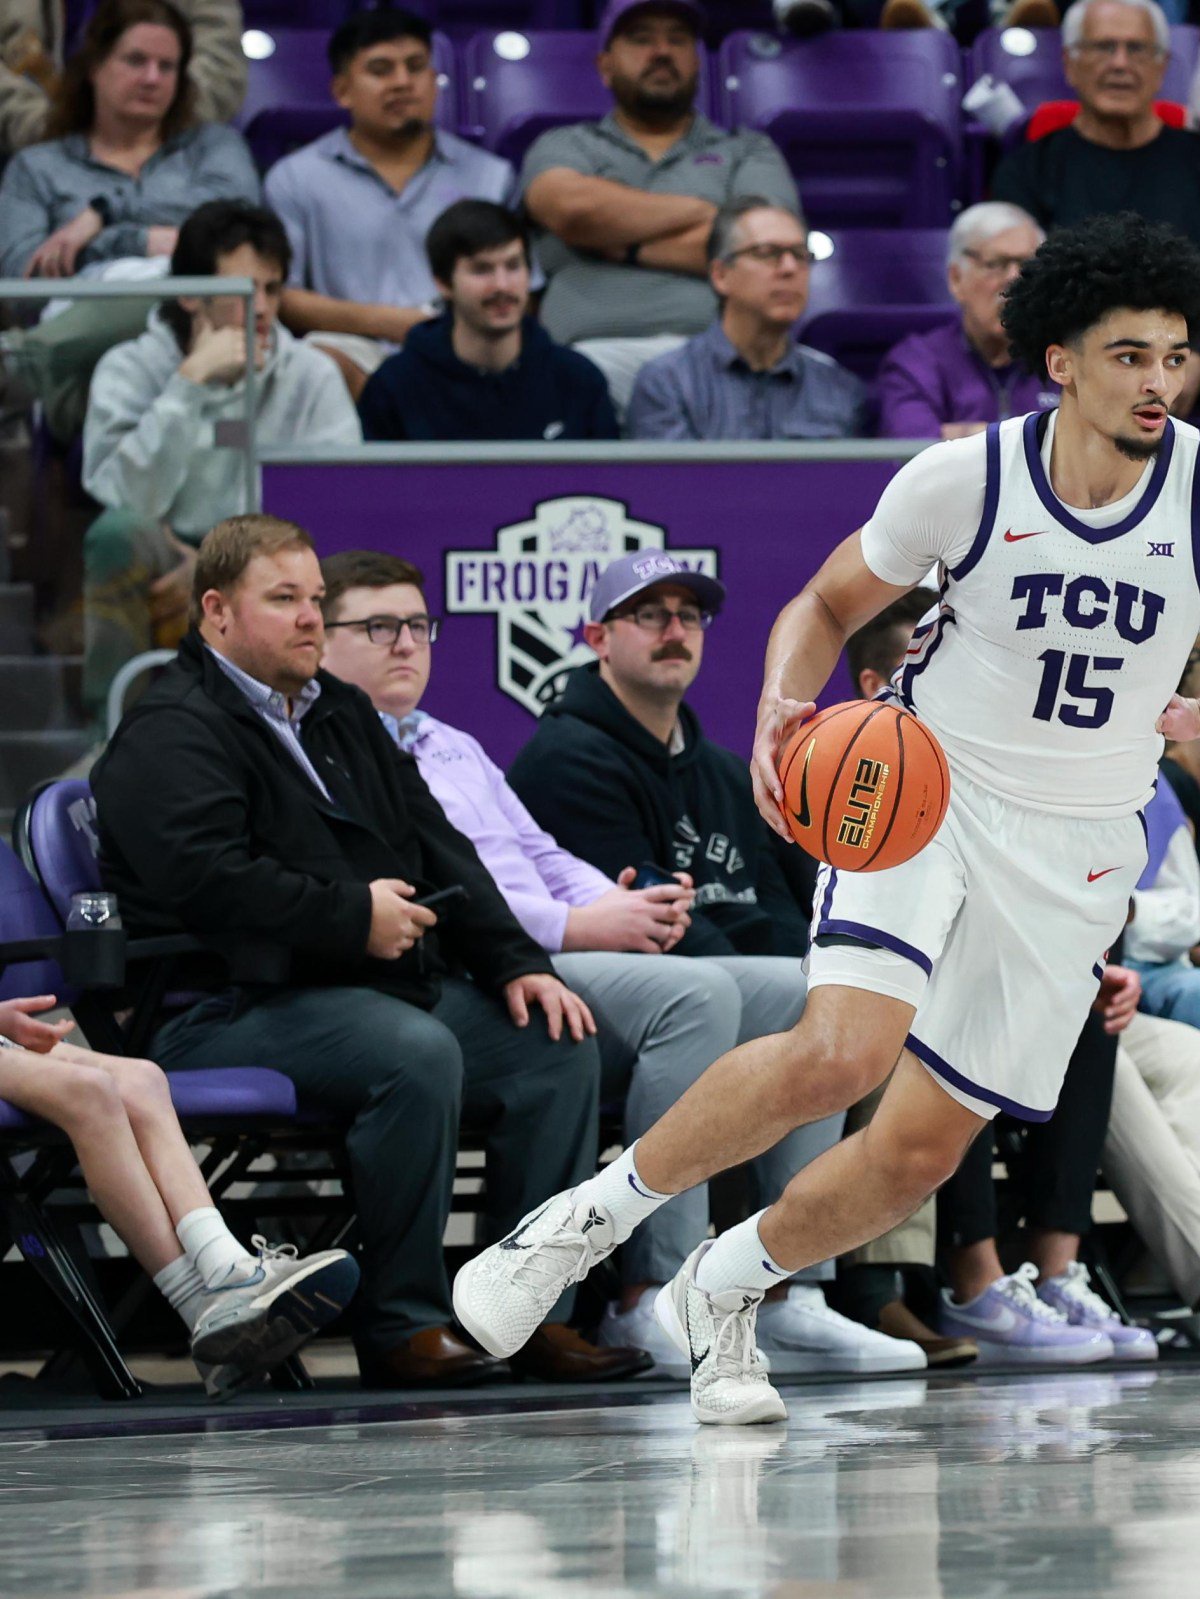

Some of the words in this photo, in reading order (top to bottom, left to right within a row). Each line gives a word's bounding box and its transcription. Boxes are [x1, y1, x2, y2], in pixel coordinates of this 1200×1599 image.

[457, 561, 568, 602] FROG
[1146, 541, 1175, 558] XII
[1010, 573, 1166, 645] TCU
[1032, 648, 1124, 729] 15
[836, 757, 884, 848] ELITE
[861, 763, 890, 850] CHAMPIONSHIP
